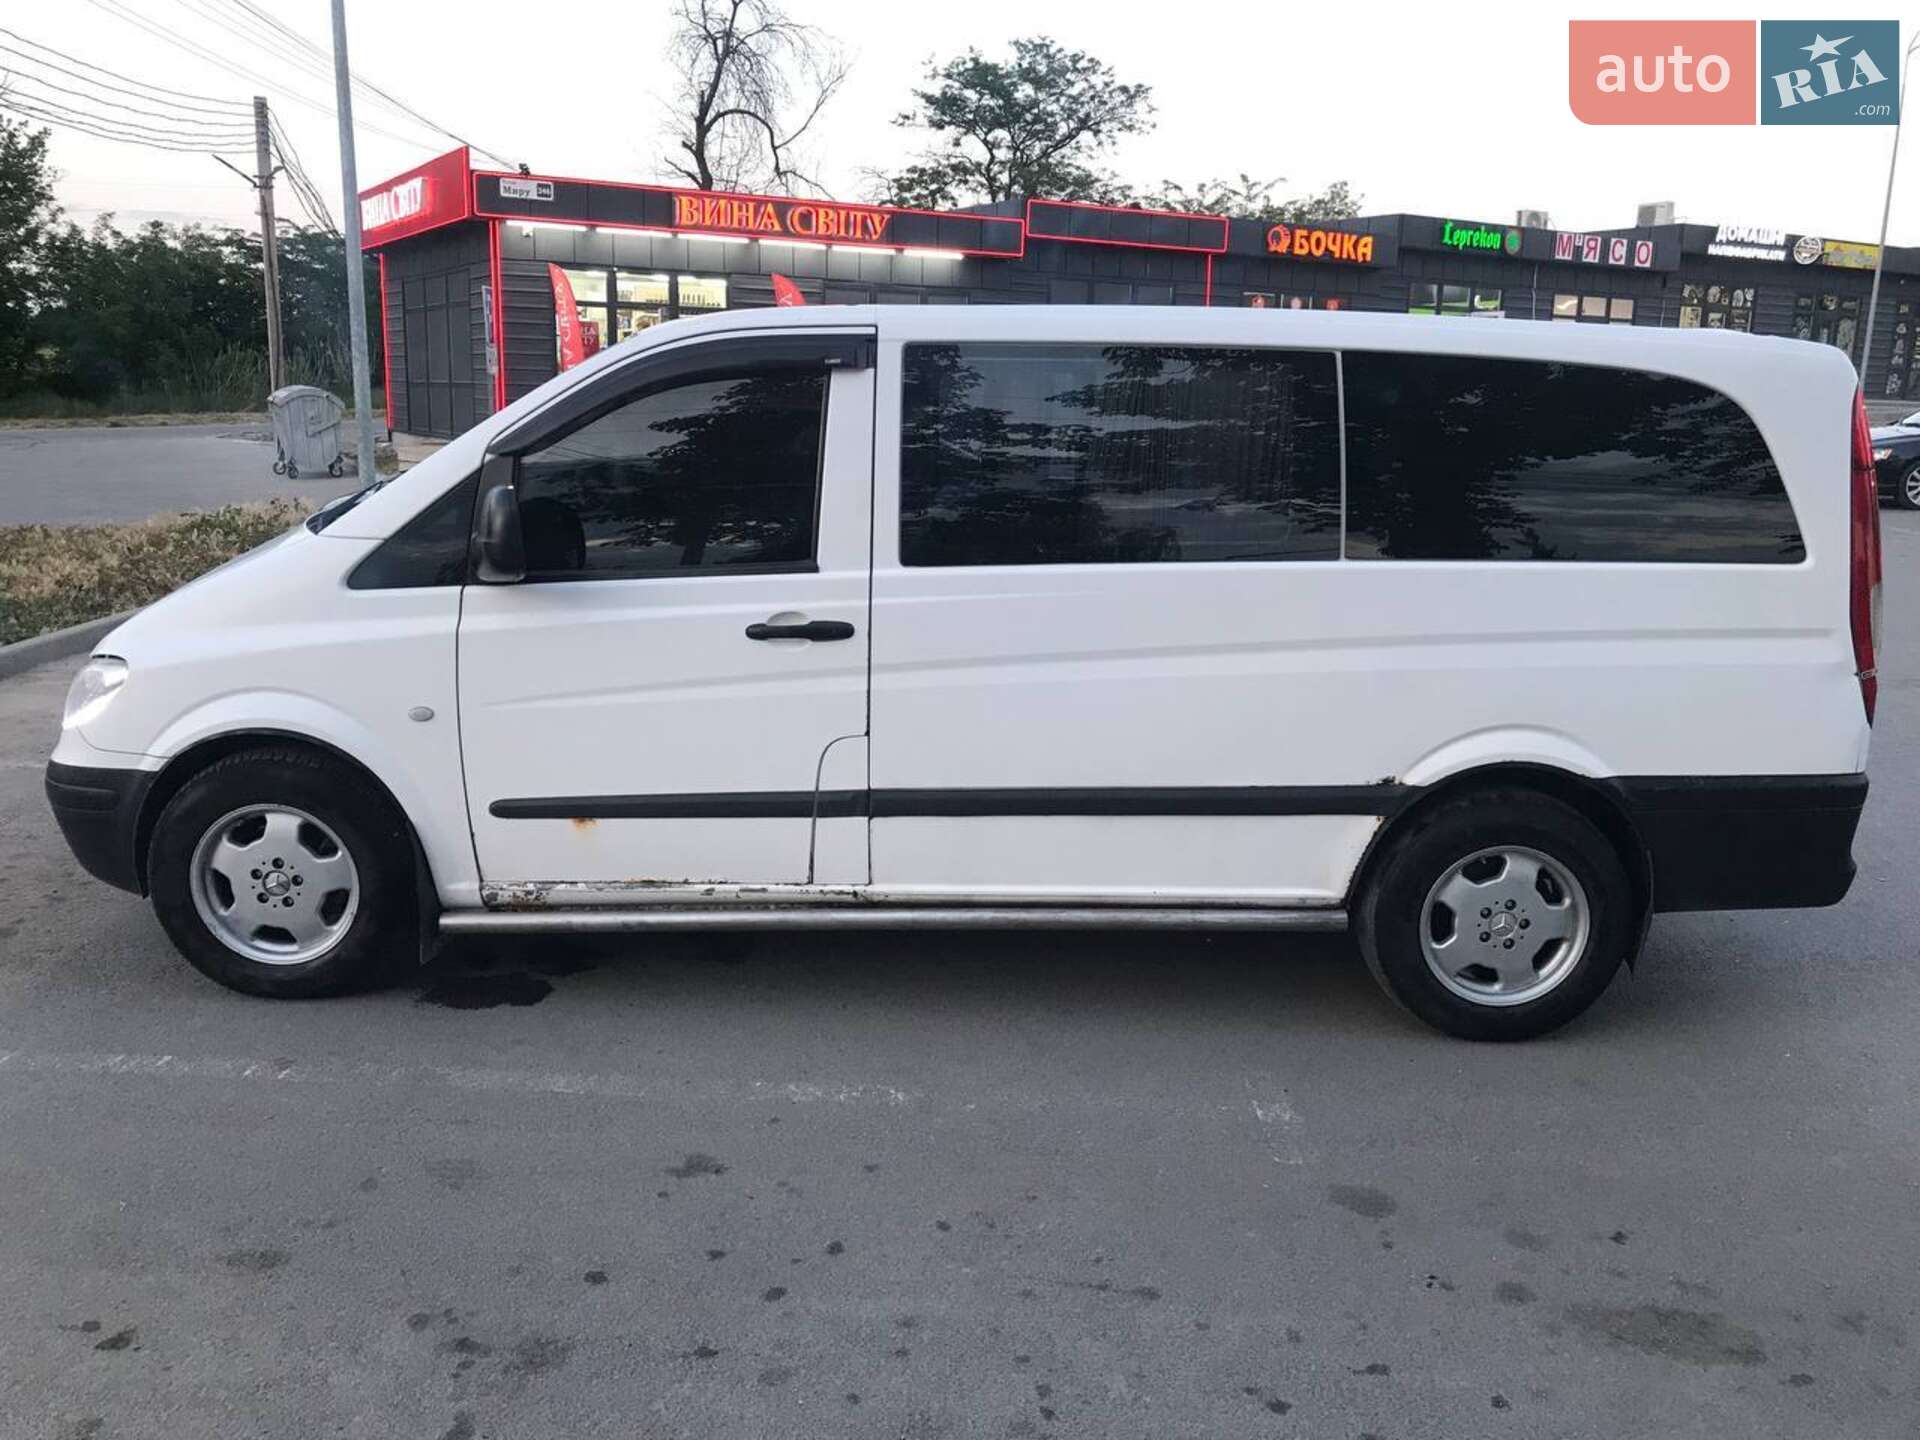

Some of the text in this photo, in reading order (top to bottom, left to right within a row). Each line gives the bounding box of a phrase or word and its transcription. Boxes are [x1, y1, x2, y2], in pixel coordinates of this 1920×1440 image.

[677, 195, 781, 232] ВИНА
[1293, 229, 1373, 263] БОЧКА
[1442, 221, 1500, 250] Leprekon
